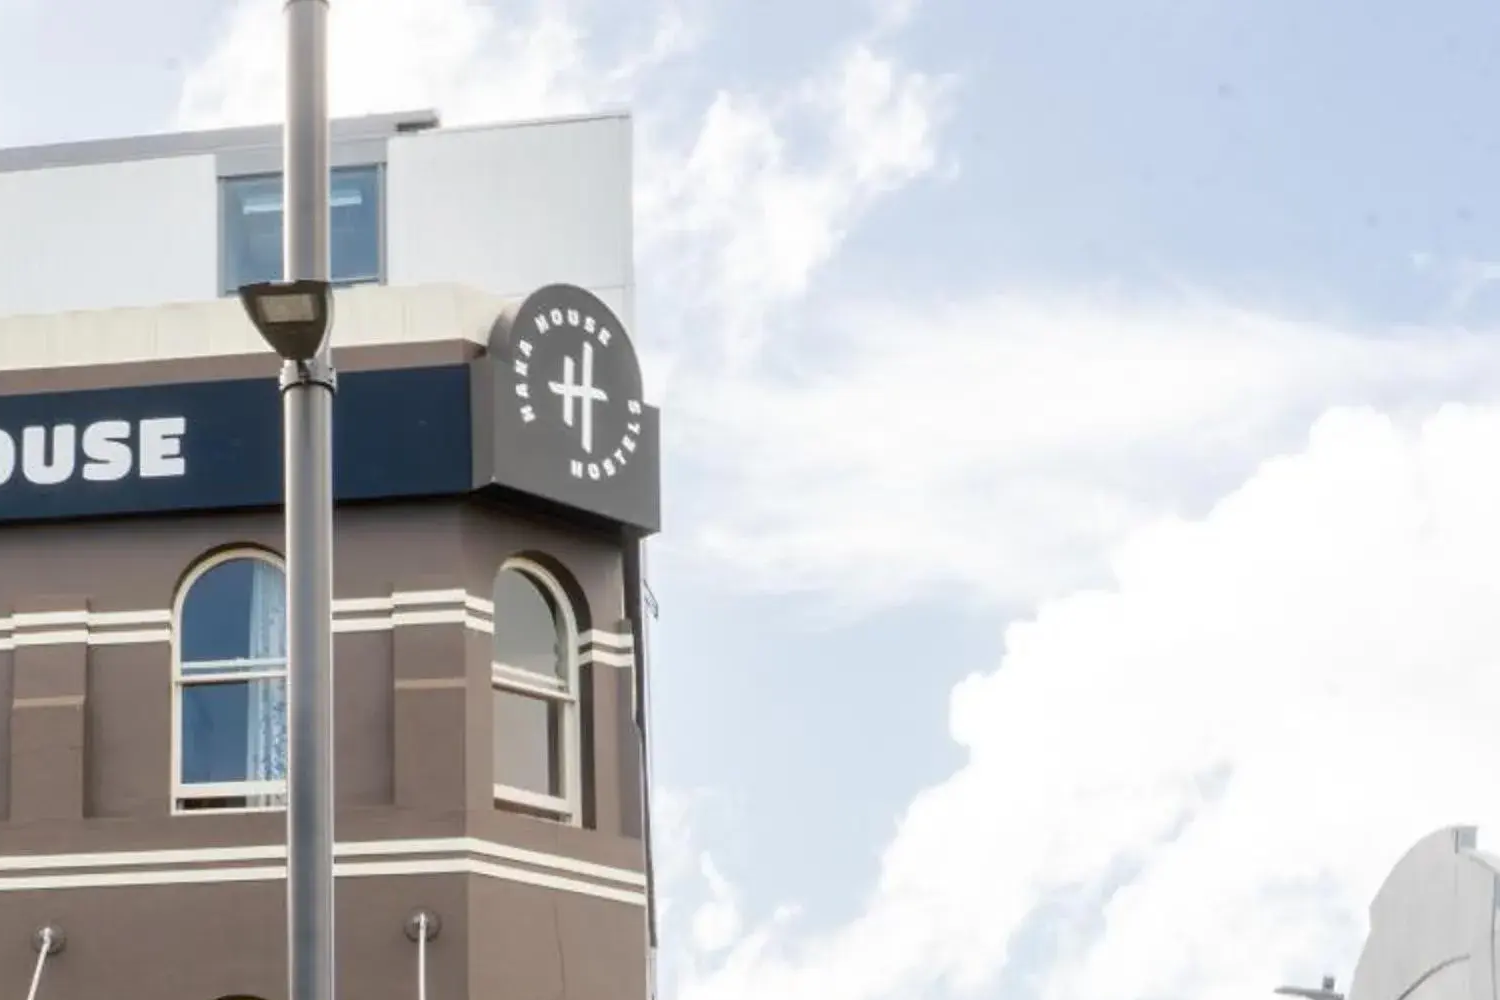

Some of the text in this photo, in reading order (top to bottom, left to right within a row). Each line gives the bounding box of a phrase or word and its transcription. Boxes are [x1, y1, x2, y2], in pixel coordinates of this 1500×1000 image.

[514, 308, 612, 423] HAKA HOUSE
[570, 399, 642, 481] HOSTELS
